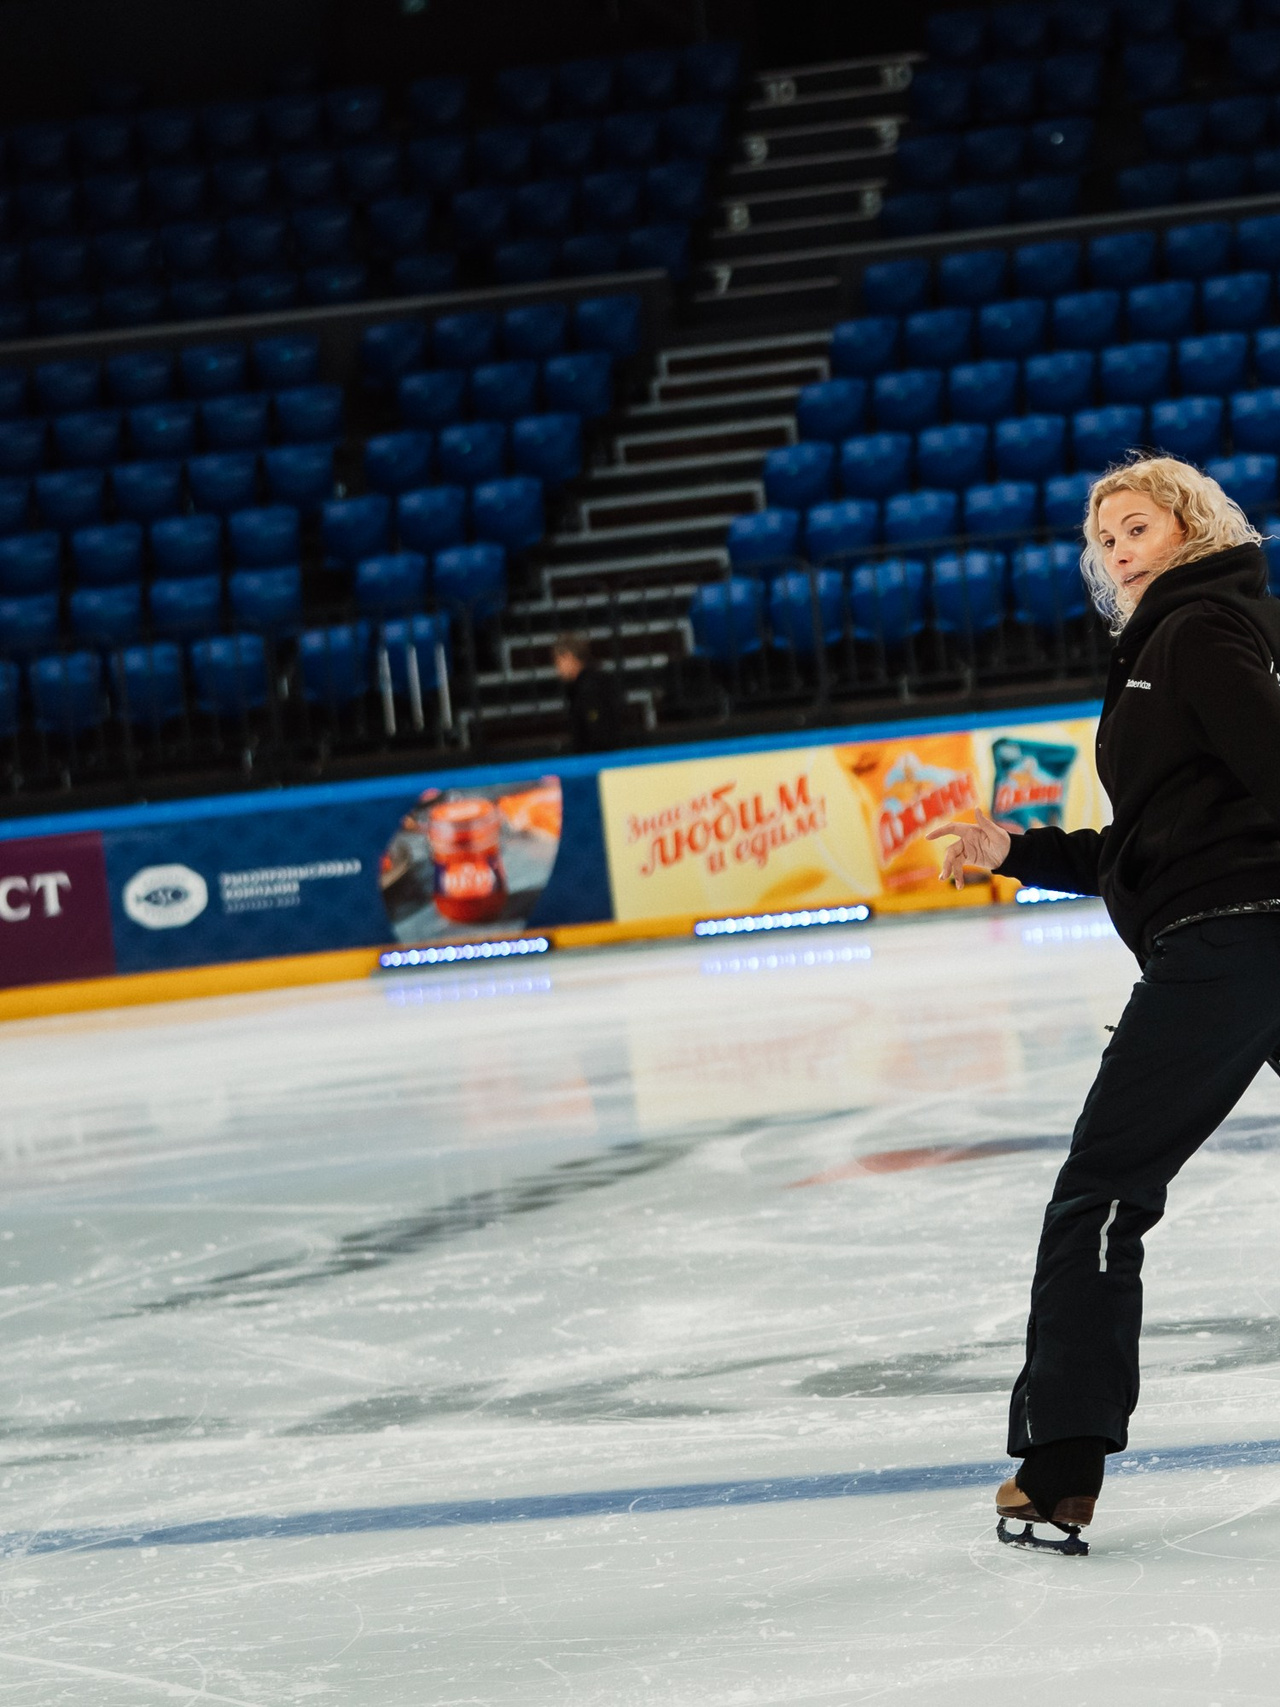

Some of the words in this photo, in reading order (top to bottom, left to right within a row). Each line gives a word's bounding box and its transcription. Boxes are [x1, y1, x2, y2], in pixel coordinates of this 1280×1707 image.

[765, 79, 797, 104] 10
[714, 264, 731, 294] 7
[707, 849, 727, 874] и
